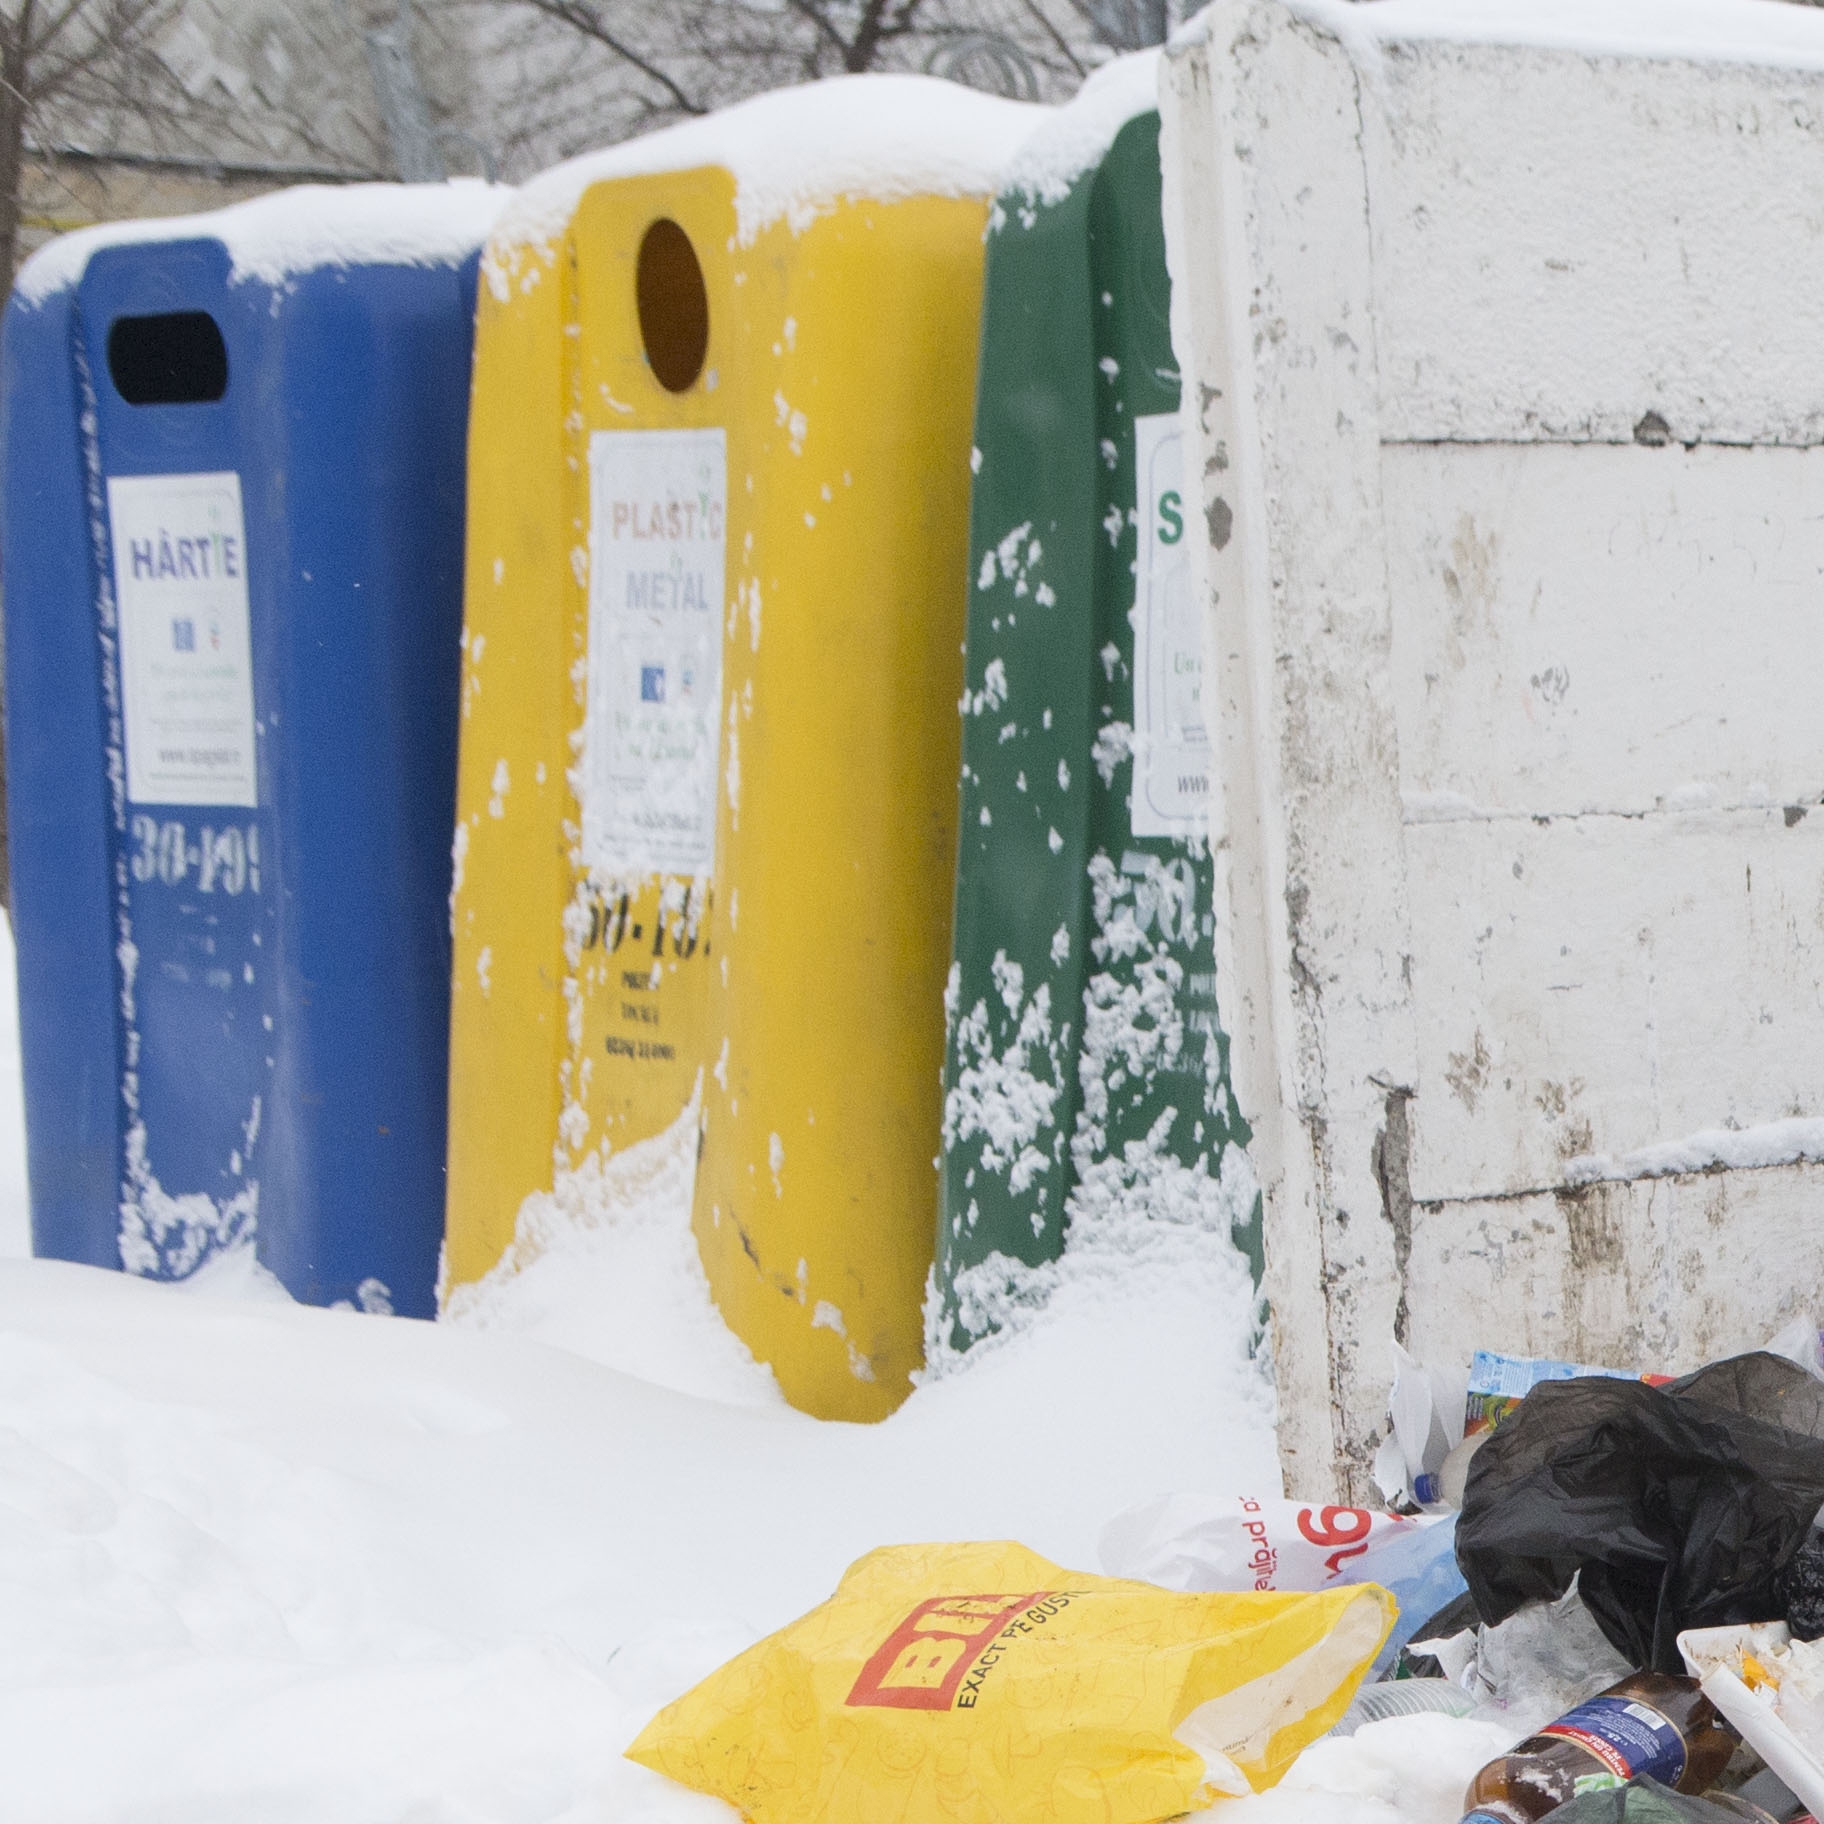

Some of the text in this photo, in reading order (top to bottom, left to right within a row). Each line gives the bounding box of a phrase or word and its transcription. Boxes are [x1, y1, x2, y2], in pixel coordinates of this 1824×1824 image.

[626, 570, 709, 611] METAL
[876, 1592, 1032, 1691] BIL
[956, 1588, 1088, 1710] EXACT PE GUST
